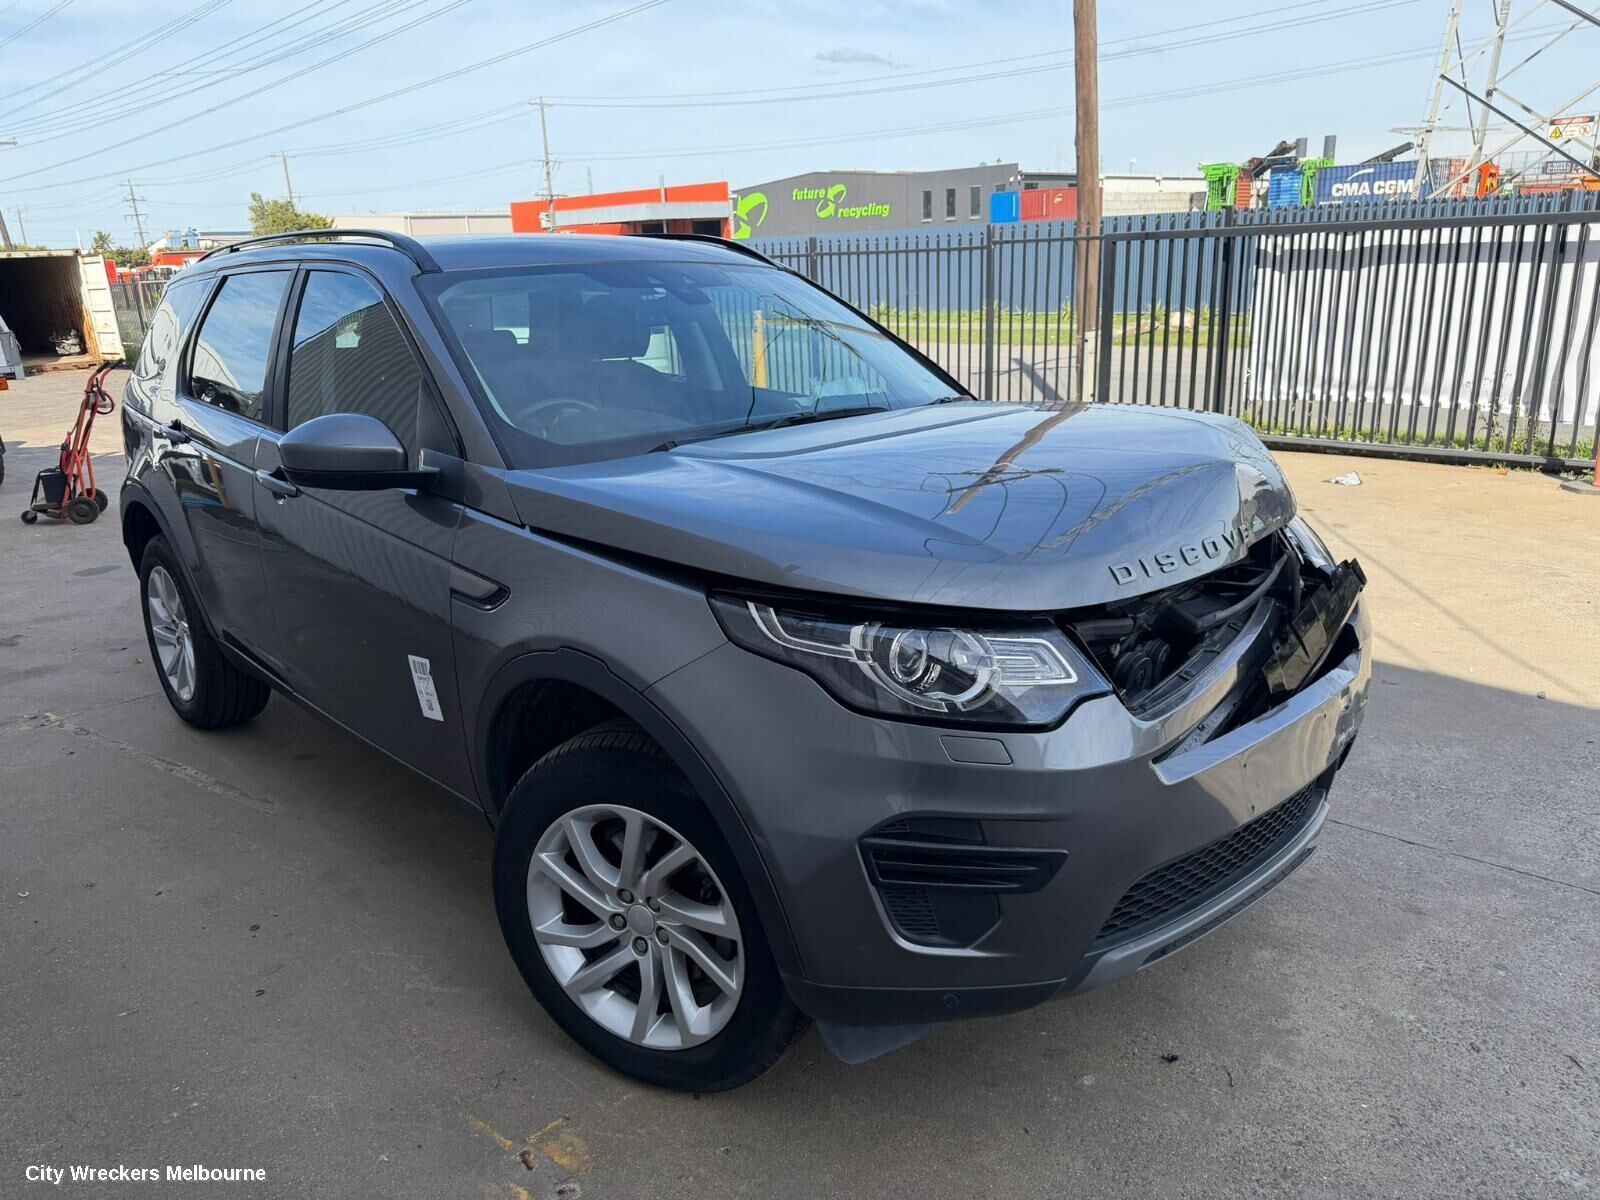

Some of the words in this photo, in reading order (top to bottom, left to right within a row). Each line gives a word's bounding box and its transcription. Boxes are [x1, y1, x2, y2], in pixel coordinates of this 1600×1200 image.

[792, 188, 826, 201] future
[1331, 182, 1371, 197] CMA
[1373, 179, 1414, 194] CGM
[837, 203, 890, 219] recycling
